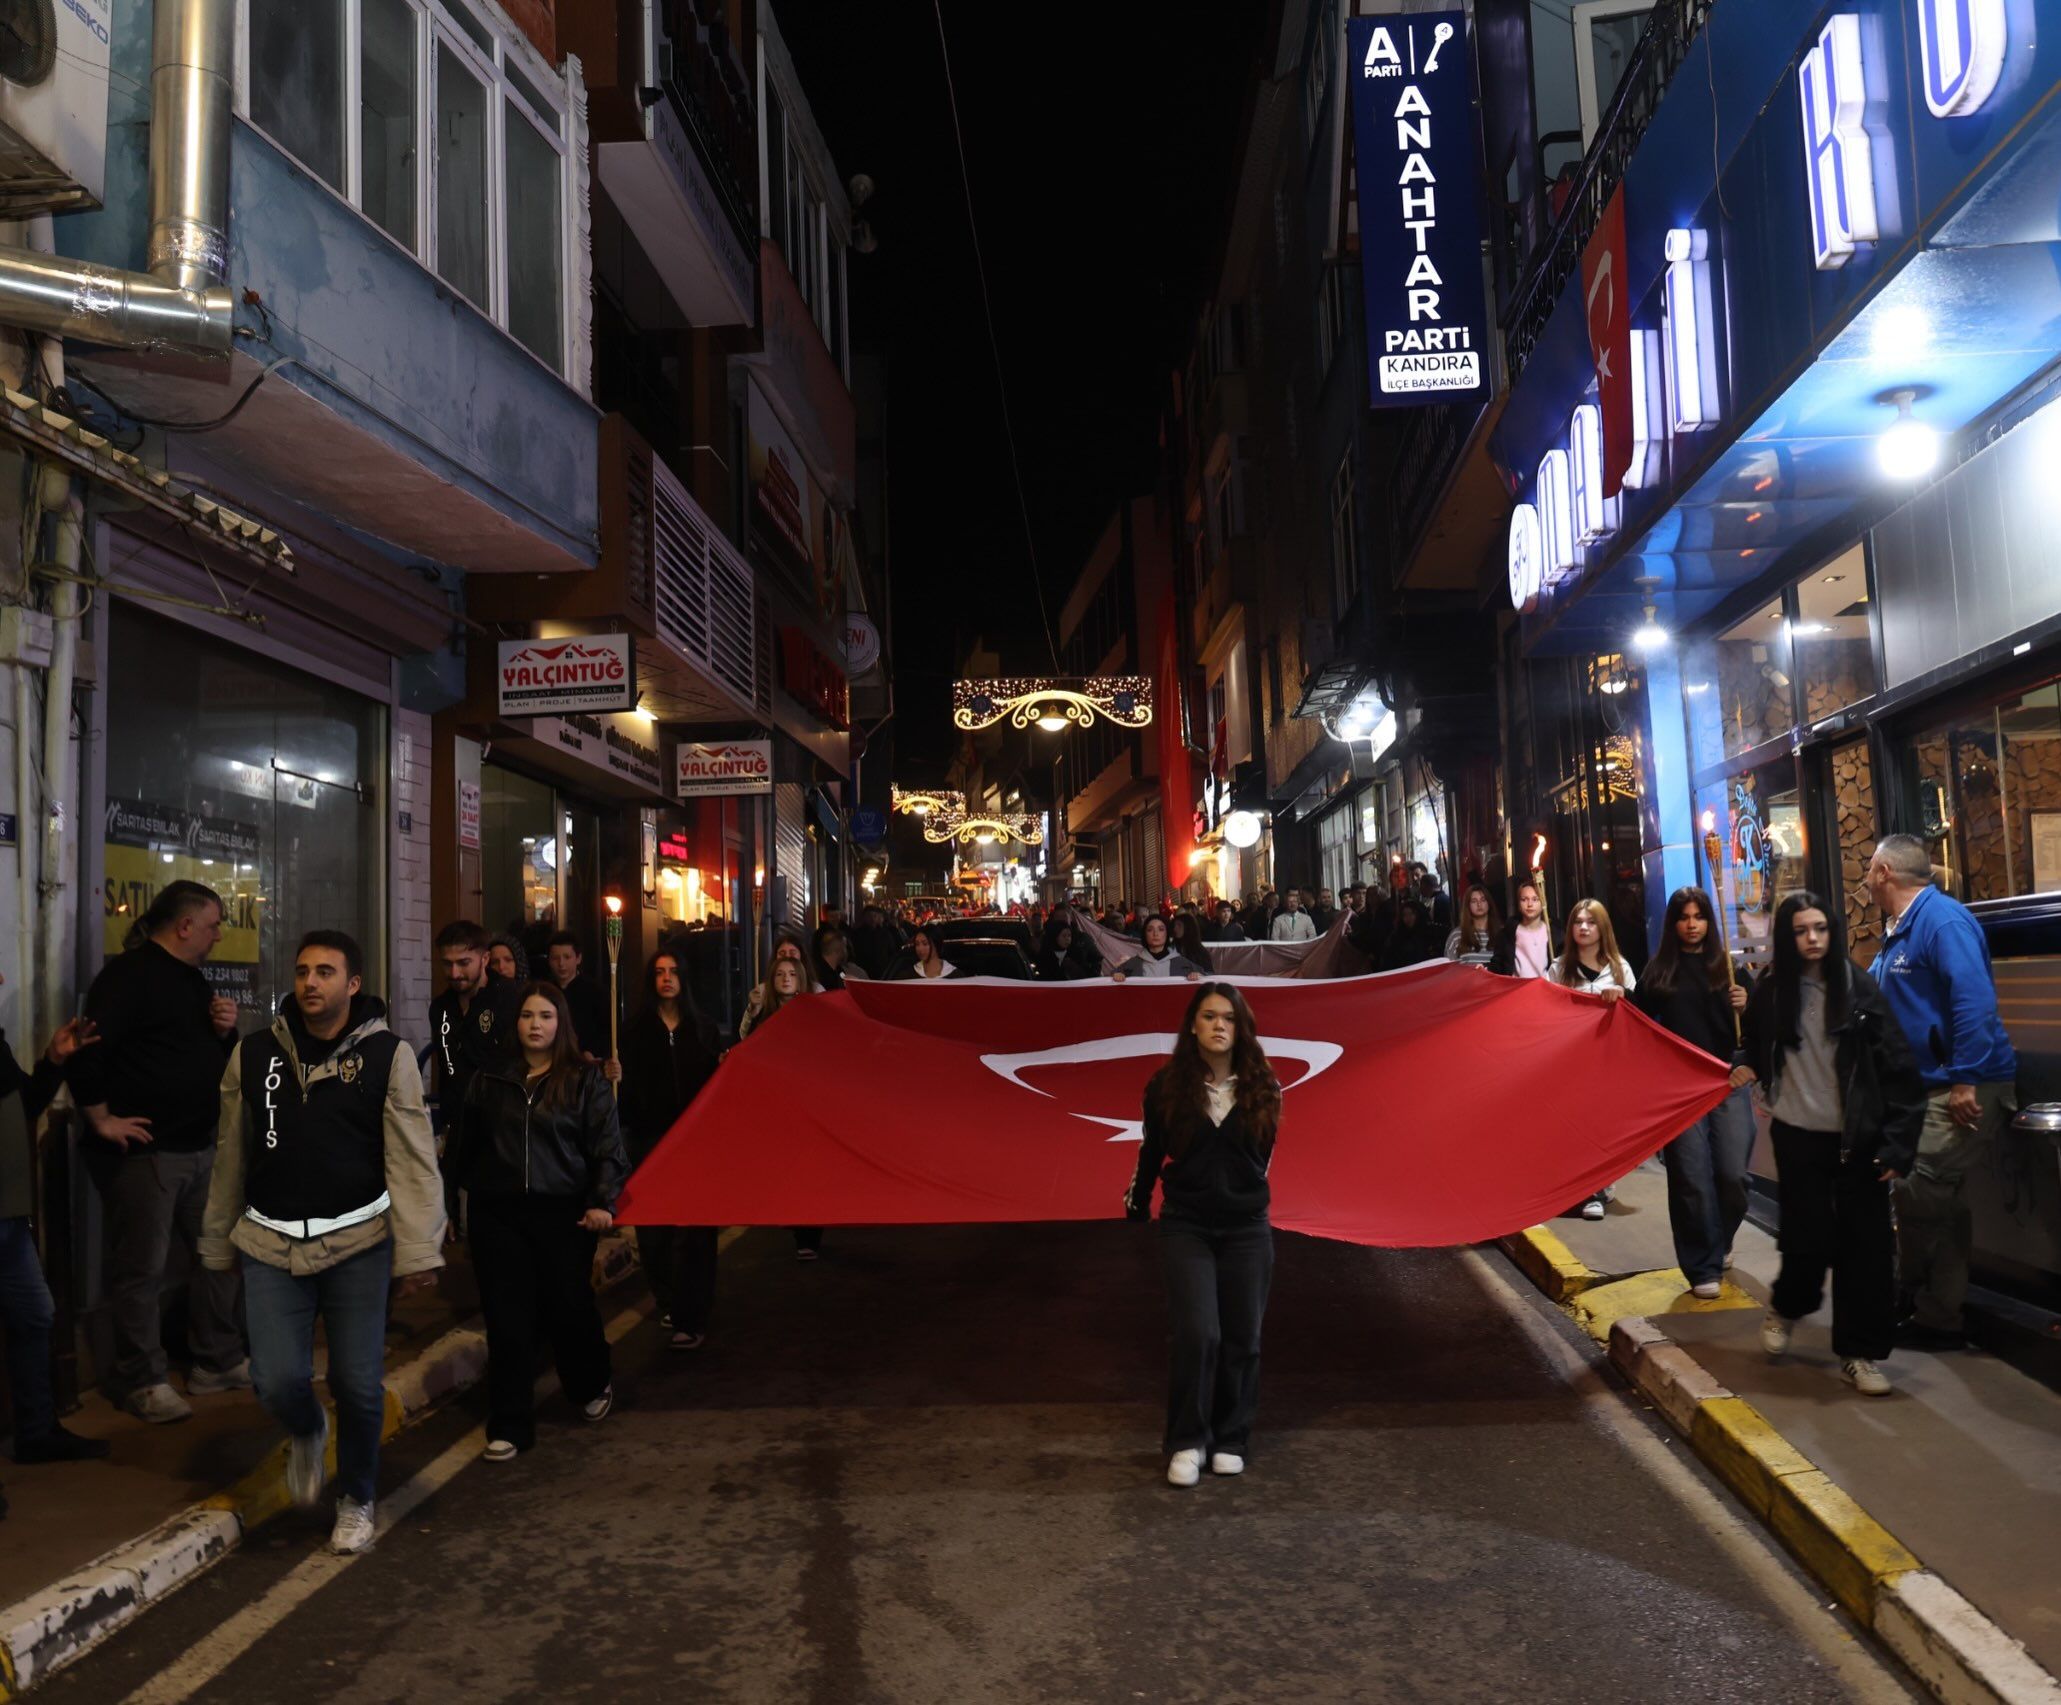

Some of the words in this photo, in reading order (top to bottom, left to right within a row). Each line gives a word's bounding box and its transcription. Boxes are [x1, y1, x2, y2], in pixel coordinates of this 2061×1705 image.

[1364, 27, 1401, 66] A
[1393, 85, 1443, 321] ANAHTAR
[1387, 355, 1473, 373] KANDIRA
[1387, 379, 1409, 391] İLÇE
[1412, 374, 1475, 389] BAŞKANLIĞI
[503, 657, 625, 688] YALÇINTUĞ
[680, 756, 768, 778] YALÇINTUĞ
[215, 967, 230, 981] 234
